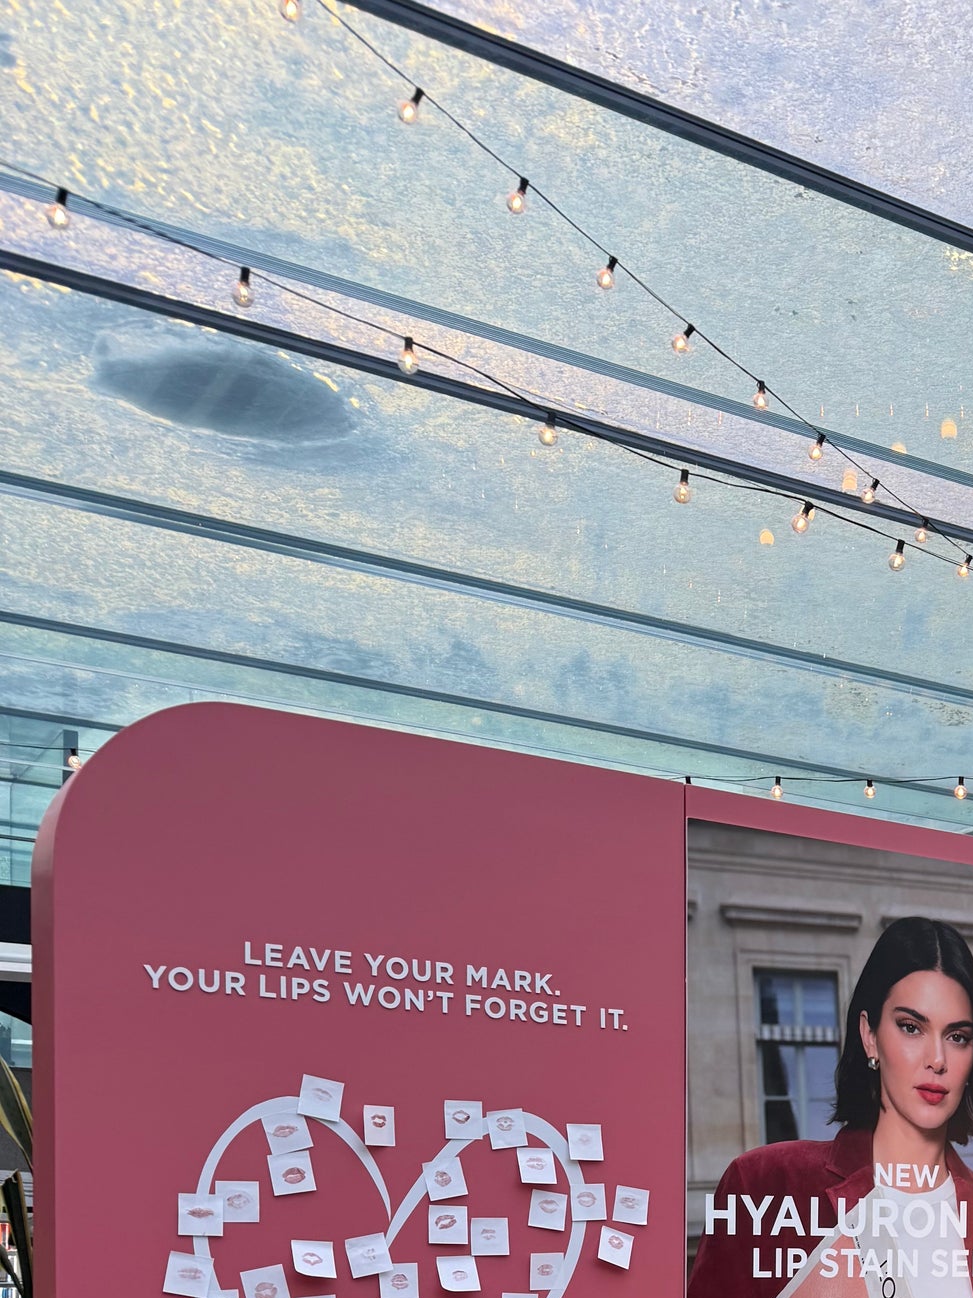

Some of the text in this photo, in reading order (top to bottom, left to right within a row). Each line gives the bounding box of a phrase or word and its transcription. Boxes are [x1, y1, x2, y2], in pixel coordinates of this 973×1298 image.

[244, 940, 562, 997] LEAVE YOUR MARK.
[143, 964, 630, 1031] YOUR LIPS WON'T FORGET IT.
[874, 1162, 939, 1189] NEW
[704, 1193, 968, 1239] HYALURON
[752, 1247, 808, 1278] LIP
[819, 1248, 918, 1278] STAIN
